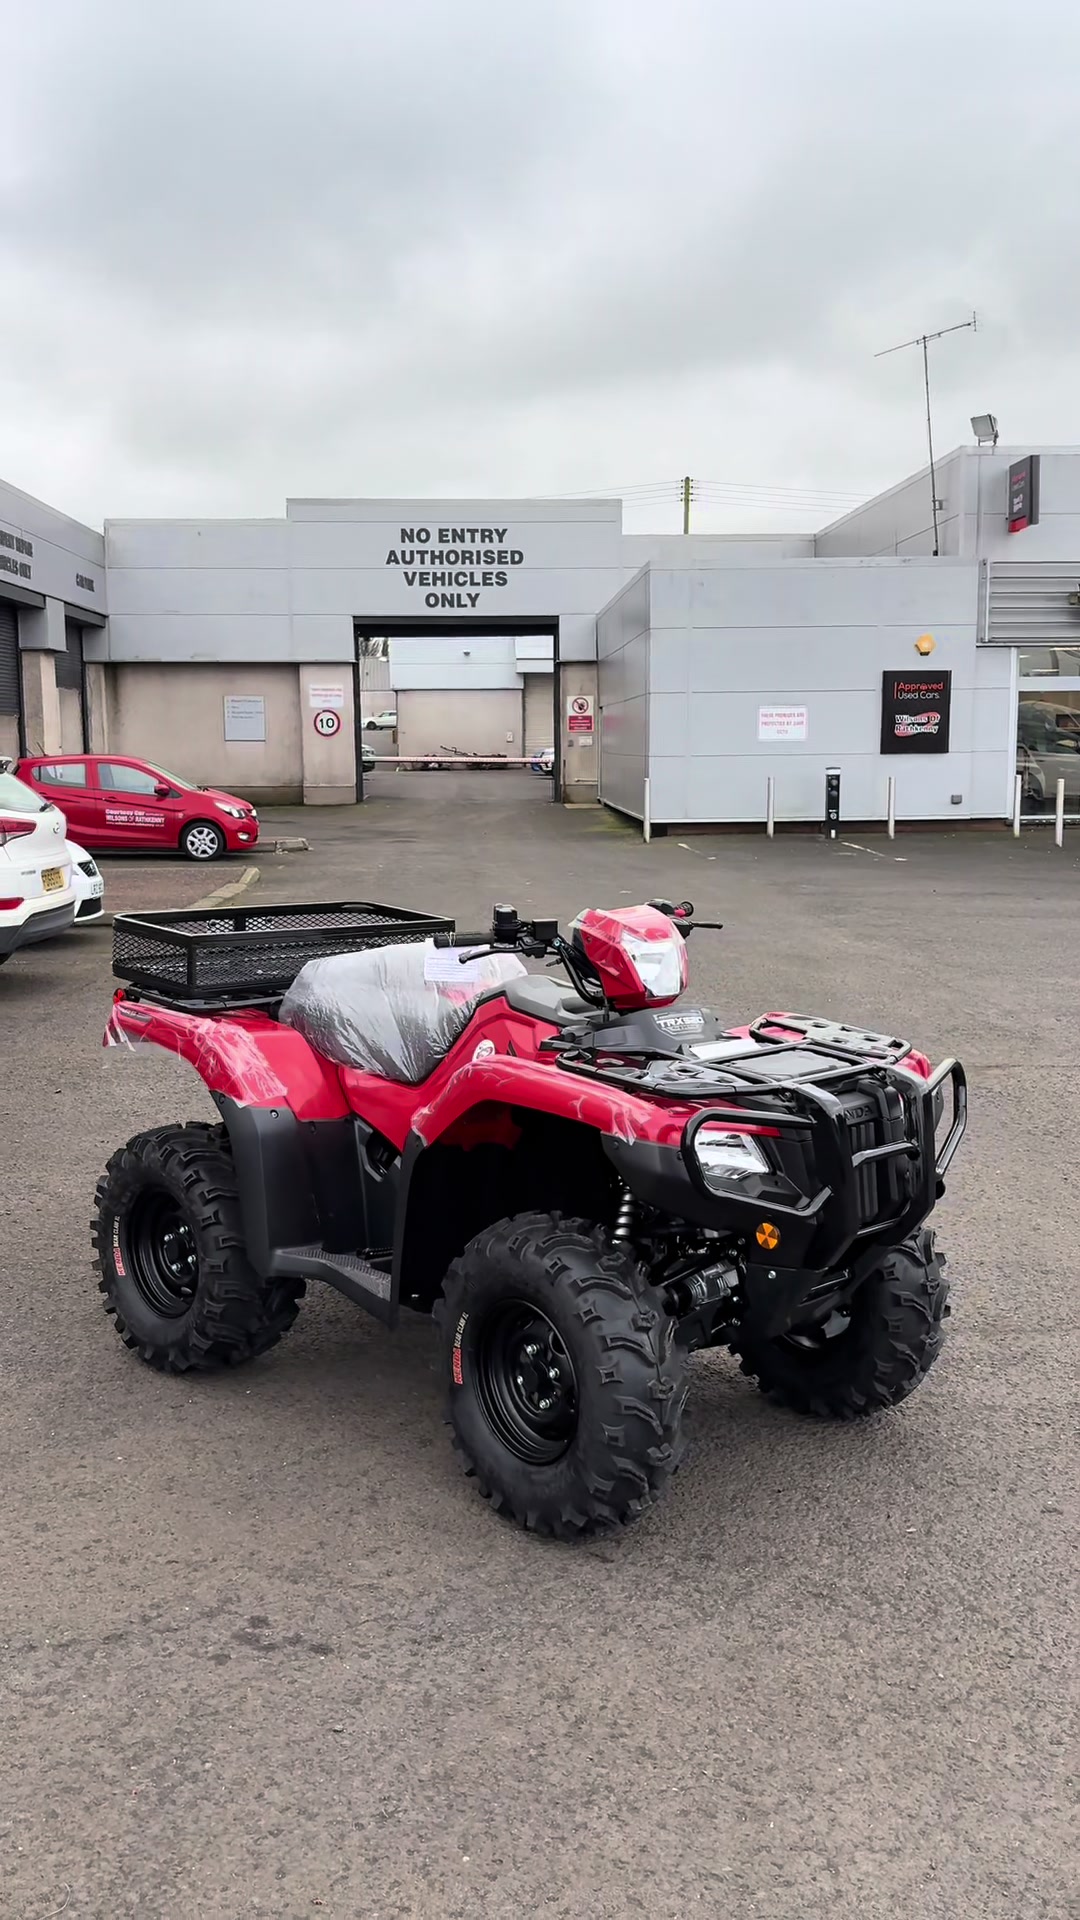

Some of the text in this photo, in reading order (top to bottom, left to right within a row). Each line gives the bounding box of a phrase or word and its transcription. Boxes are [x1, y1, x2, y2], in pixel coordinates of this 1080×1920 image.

[400, 527, 508, 544] NO ENTRY
[385, 549, 524, 565] AUTHORISED
[403, 571, 508, 587] VEHICLES
[424, 592, 480, 608] ONLY
[897, 691, 919, 699] Used
[898, 682, 944, 692] Approved
[319, 717, 335, 729] 10
[113, 1247, 126, 1276] KENDA
[452, 1347, 463, 1385] KENDA
